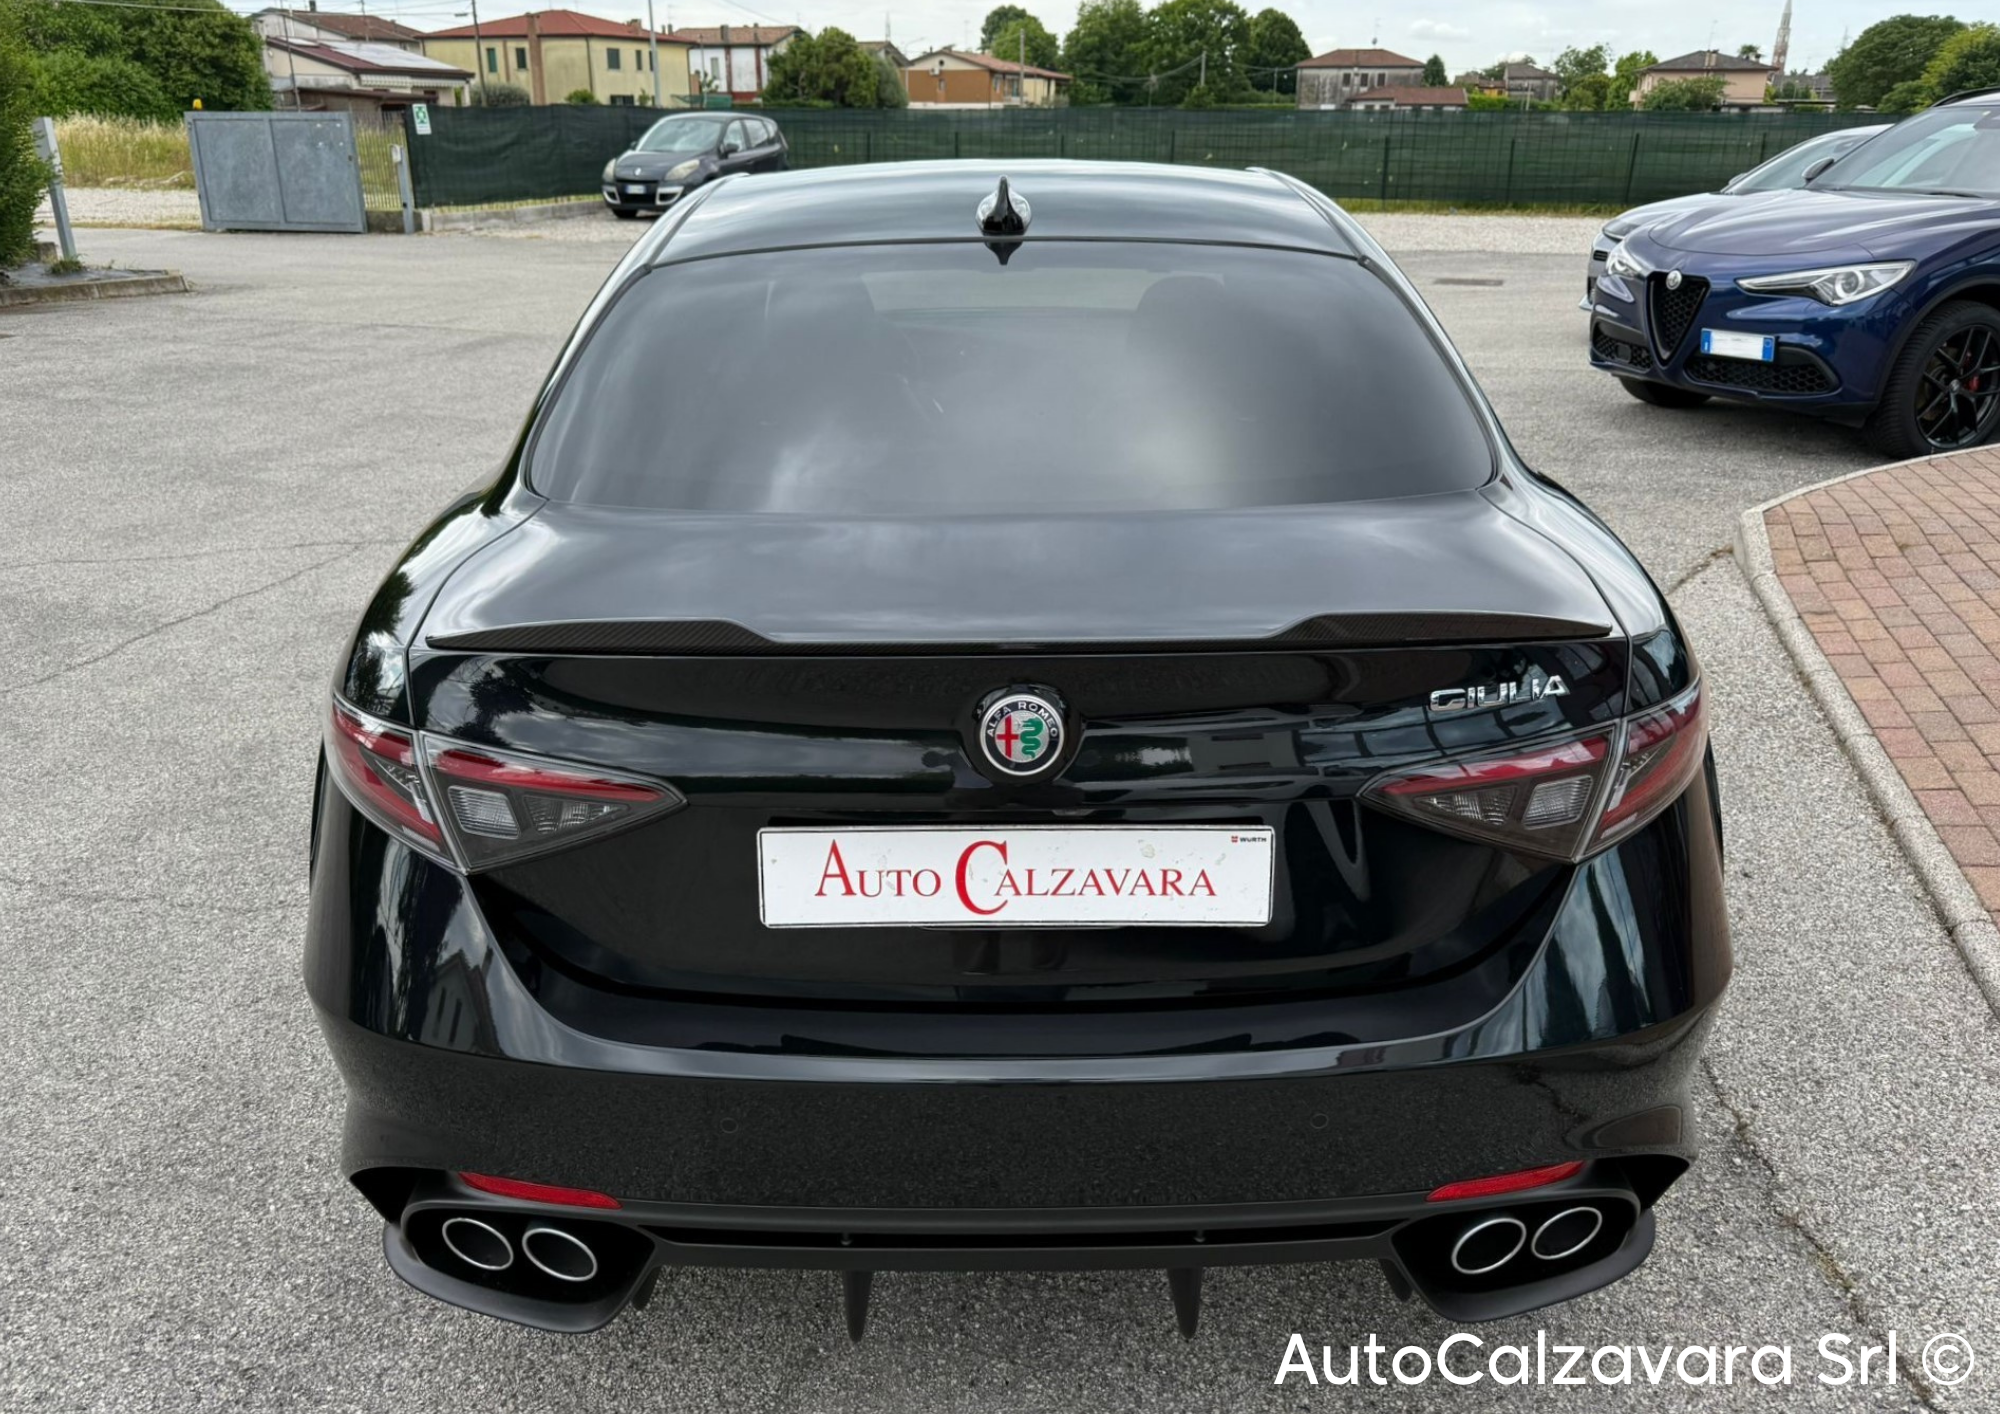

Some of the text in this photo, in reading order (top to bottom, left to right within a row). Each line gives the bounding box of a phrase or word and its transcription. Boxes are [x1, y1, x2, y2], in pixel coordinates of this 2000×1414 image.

[1430, 675, 1571, 712] GIULIA
[986, 701, 1058, 738] ALFA ROMEO
[814, 839, 1217, 915] AUTO CALZAVARA
